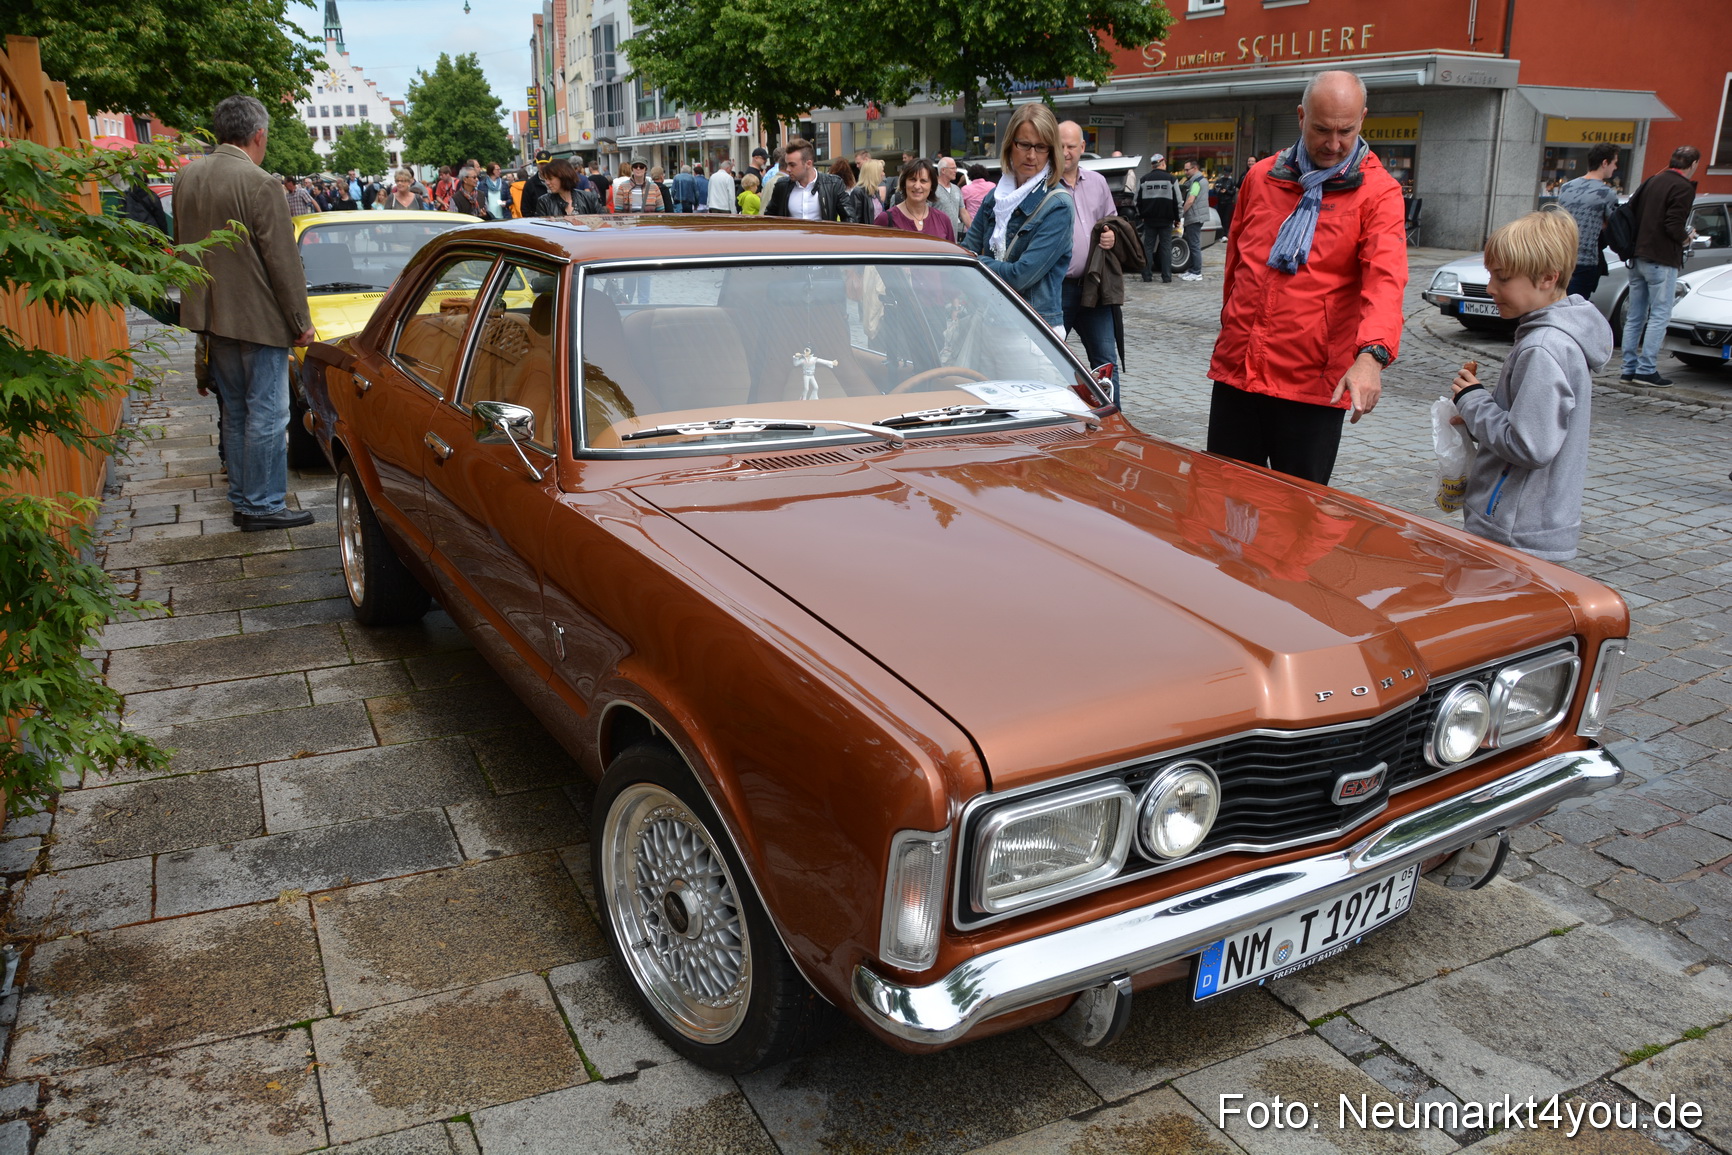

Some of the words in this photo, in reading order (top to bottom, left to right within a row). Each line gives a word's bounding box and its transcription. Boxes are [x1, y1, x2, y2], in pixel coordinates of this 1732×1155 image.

[1237, 24, 1376, 60] SCHLIERF
[1193, 132, 1235, 141] SCHLIERF
[1362, 128, 1418, 138] SCHLIERF
[1581, 131, 1633, 142] SCHLIERF
[1465, 303, 1475, 313] NM
[1480, 304, 1489, 314] CX
[1315, 667, 1415, 703] FORD
[1340, 774, 1379, 798] GXL
[1401, 866, 1414, 882] 05
[1394, 894, 1408, 910] 07
[1222, 926, 1273, 985] NM
[1272, 956, 1318, 981] FREISTAAT
[1317, 942, 1350, 962] BAYERN
[1202, 974, 1212, 988] D
